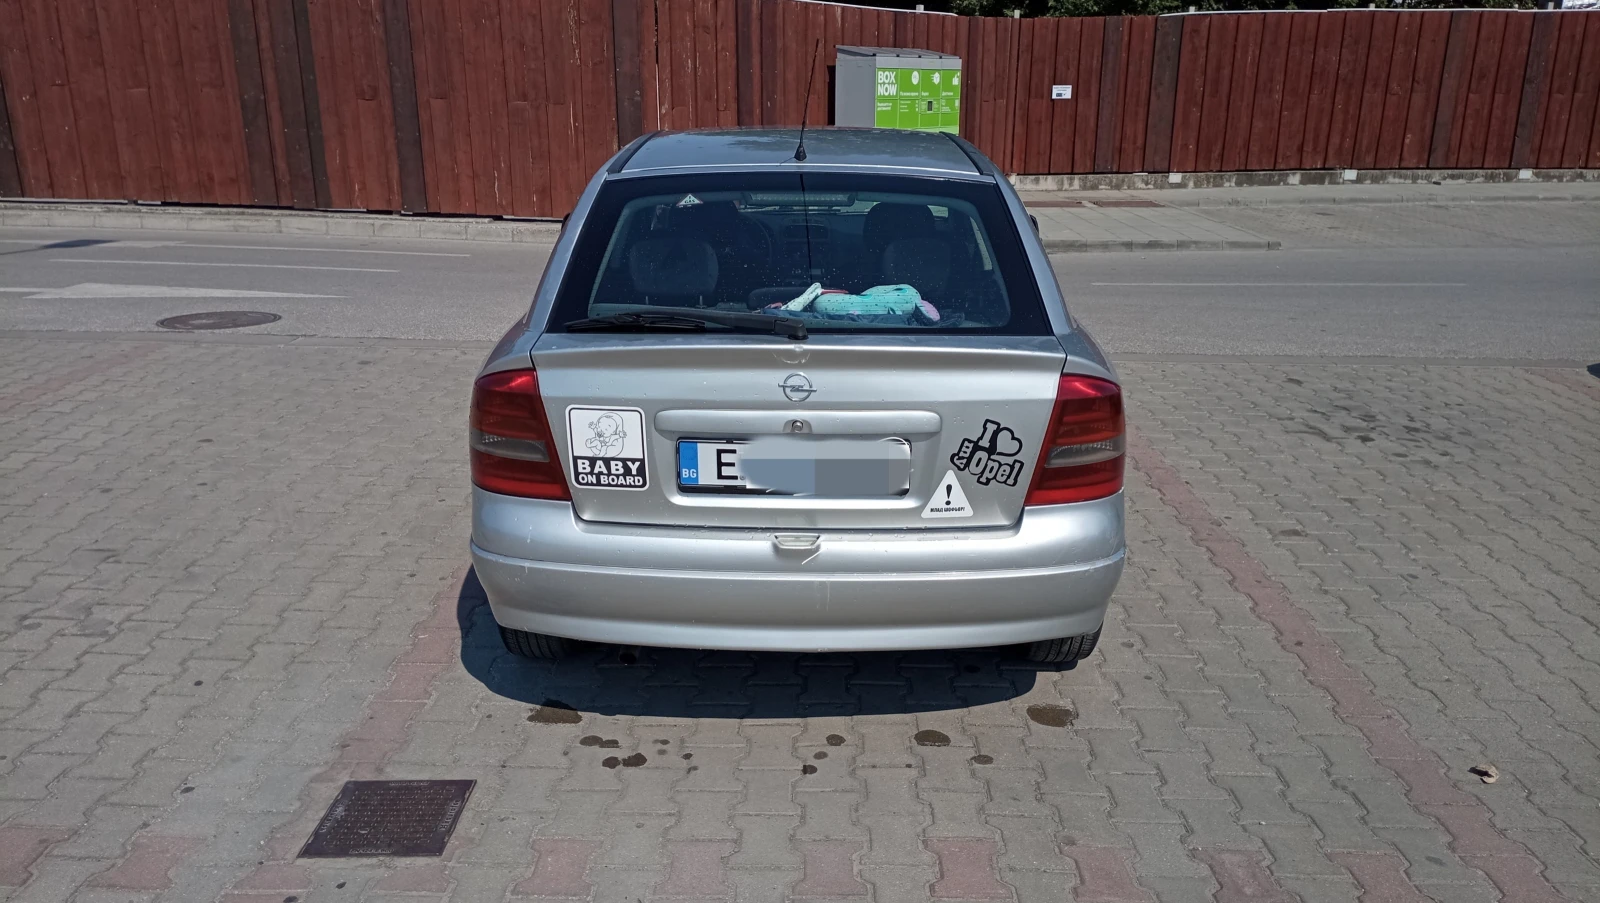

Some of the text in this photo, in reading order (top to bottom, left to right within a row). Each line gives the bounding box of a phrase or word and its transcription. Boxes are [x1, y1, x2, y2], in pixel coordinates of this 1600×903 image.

[878, 71, 896, 83] BOX
[878, 84, 897, 96] NOW
[977, 420, 999, 448] I
[953, 440, 974, 469] my
[577, 459, 641, 475] BABY
[682, 469, 697, 478] BG
[968, 450, 1021, 486] Opel
[579, 474, 643, 486] ON BOARD
